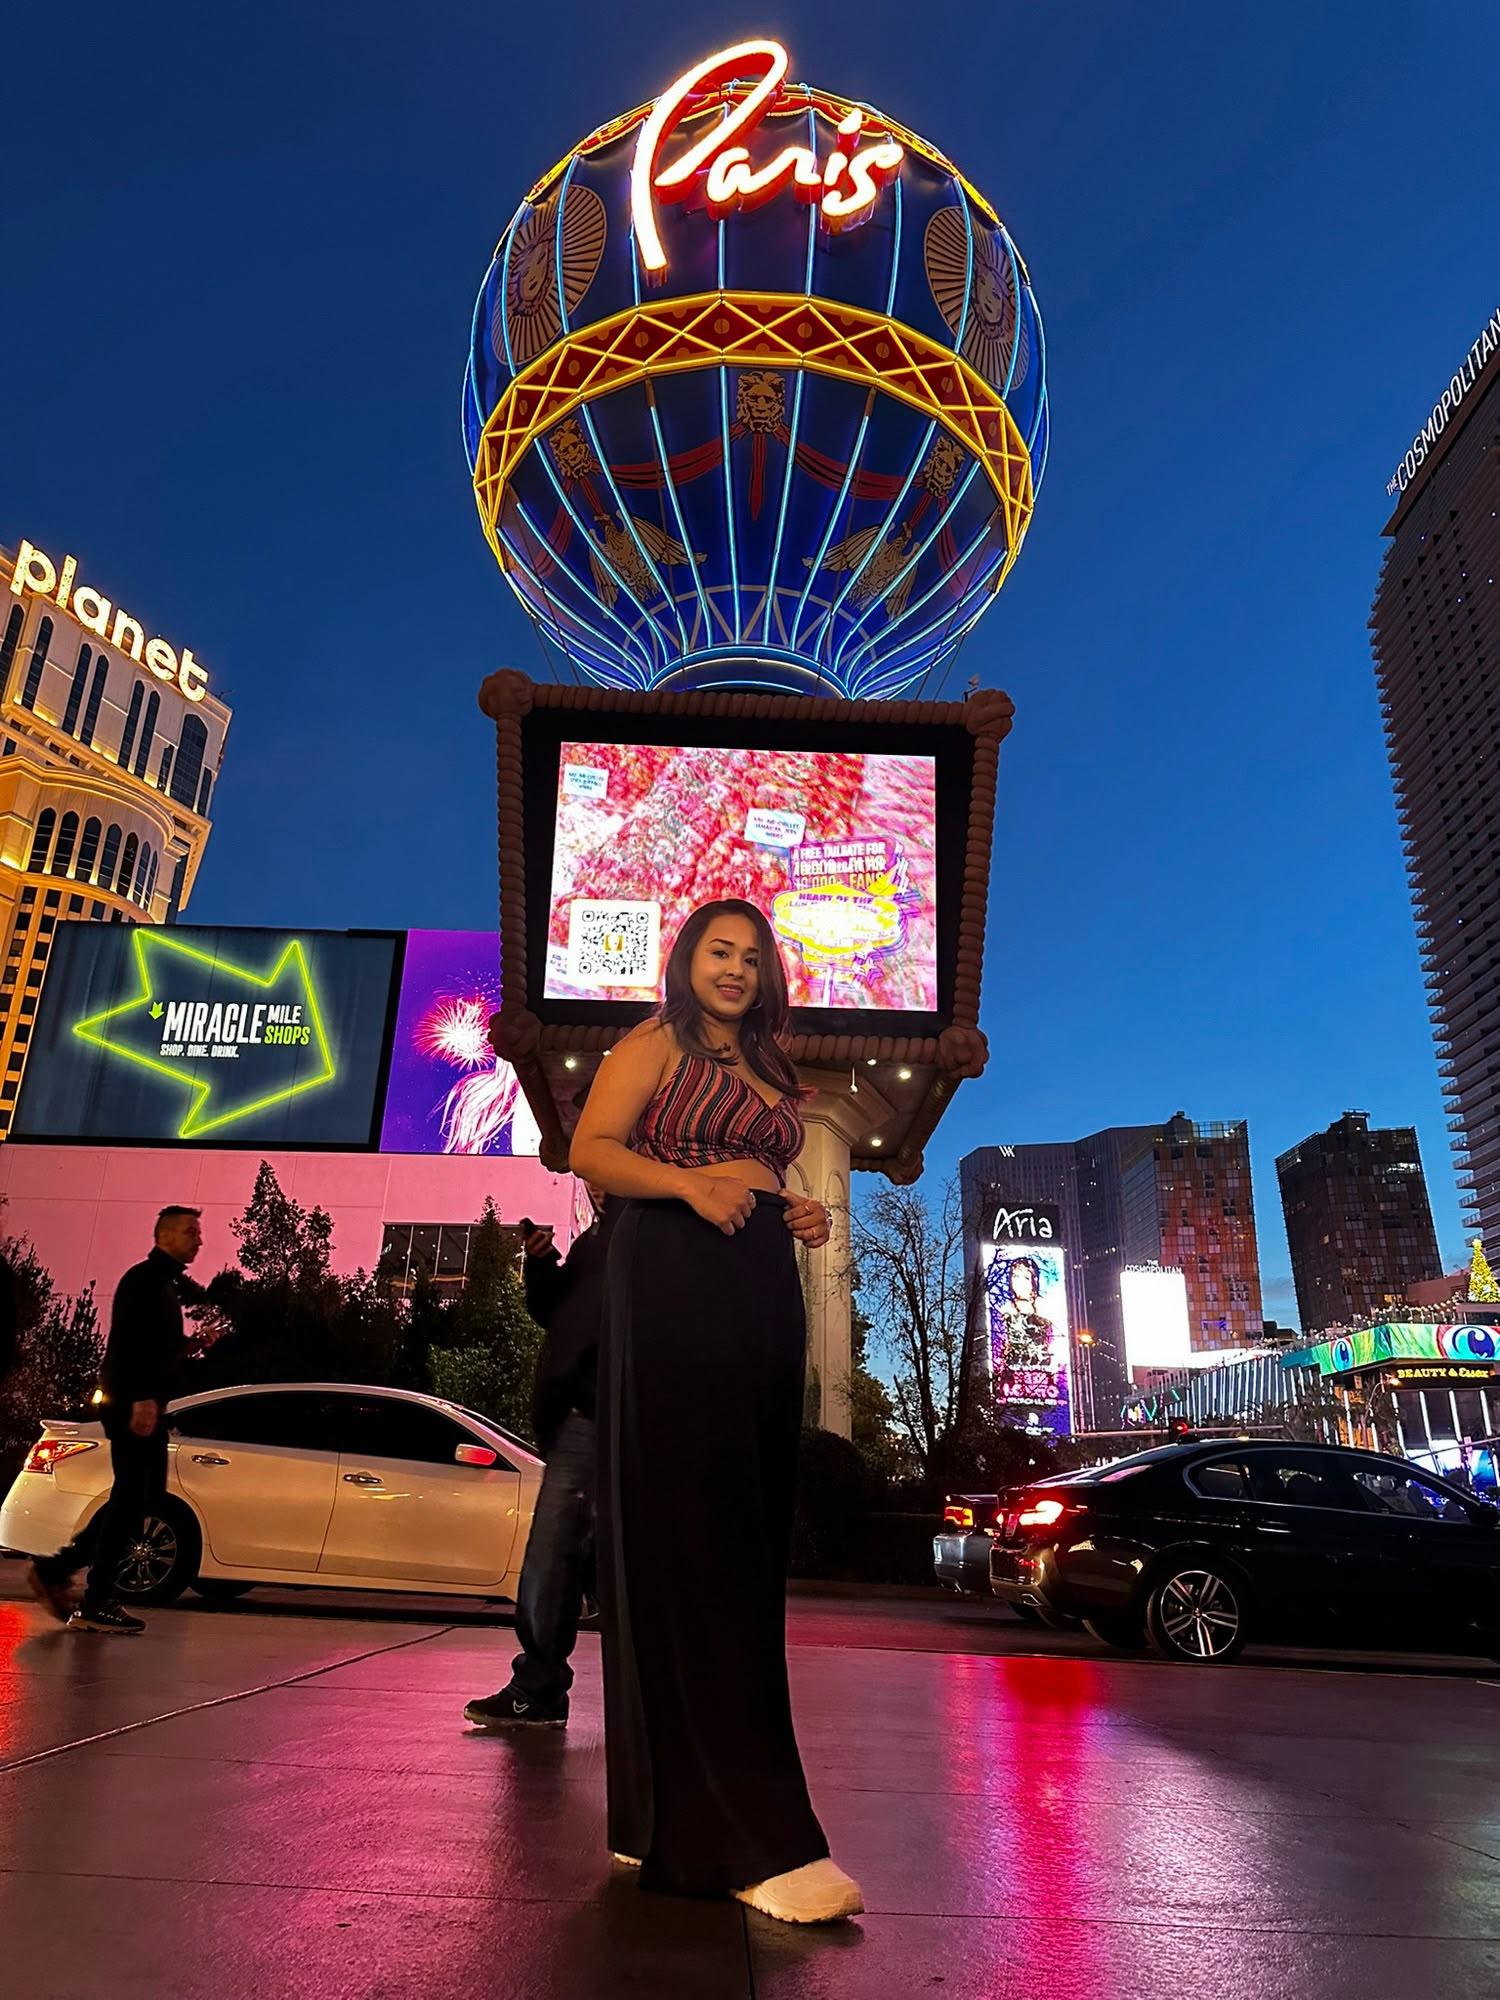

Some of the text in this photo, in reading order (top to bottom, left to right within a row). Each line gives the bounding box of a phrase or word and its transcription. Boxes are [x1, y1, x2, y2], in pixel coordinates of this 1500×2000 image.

[631, 40, 903, 271] Paris
[1397, 308, 1500, 491] COSMOPOLITAN
[9, 539, 209, 702] planet
[162, 1002, 302, 1043] MIRACLE MILE
[264, 1025, 310, 1045] SHOPS
[993, 1208, 1053, 1239] Aria
[1125, 1264, 1182, 1274] COSMOPOLITAN
[1397, 1367, 1447, 1378] BEAUTY
[1448, 1367, 1458, 1377] &
